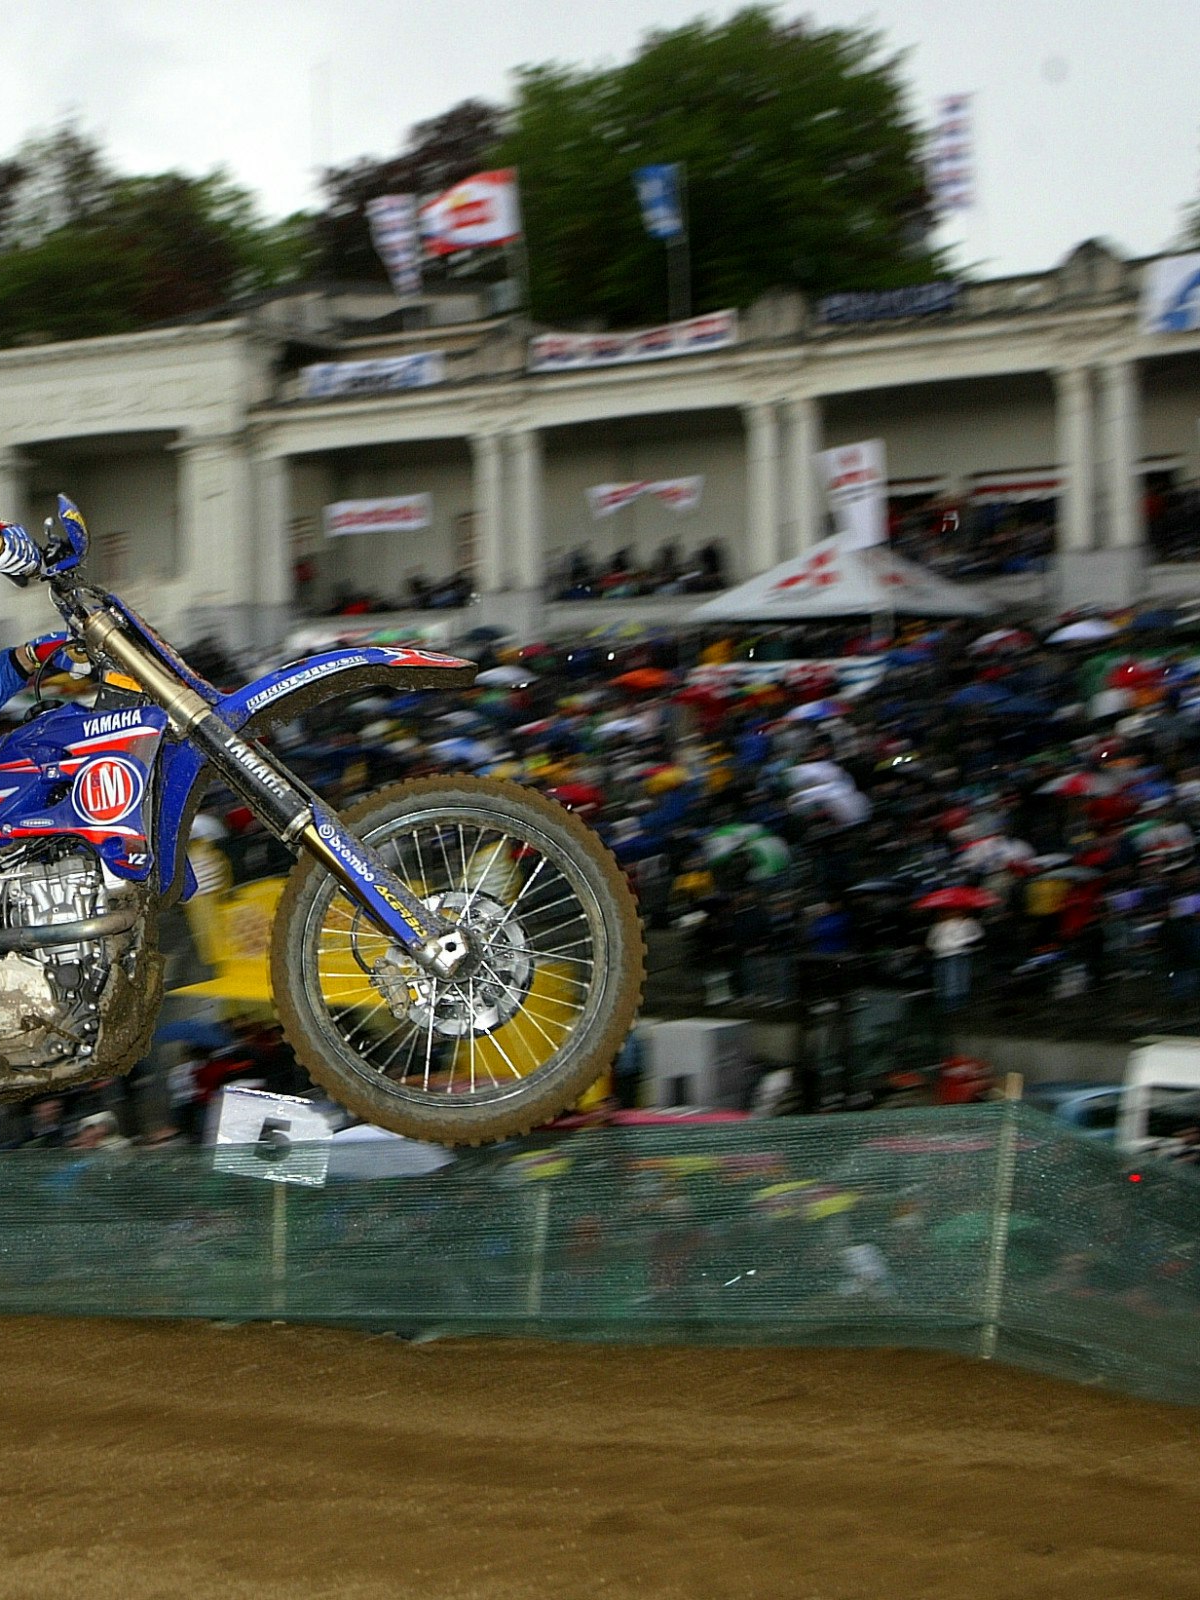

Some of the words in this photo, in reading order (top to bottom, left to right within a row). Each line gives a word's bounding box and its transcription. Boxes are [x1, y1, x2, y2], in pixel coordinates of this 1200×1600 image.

[83, 709, 142, 737] YAMAHA
[127, 852, 148, 865] YZ
[328, 835, 375, 882] brembo
[253, 1116, 293, 1162] 5
